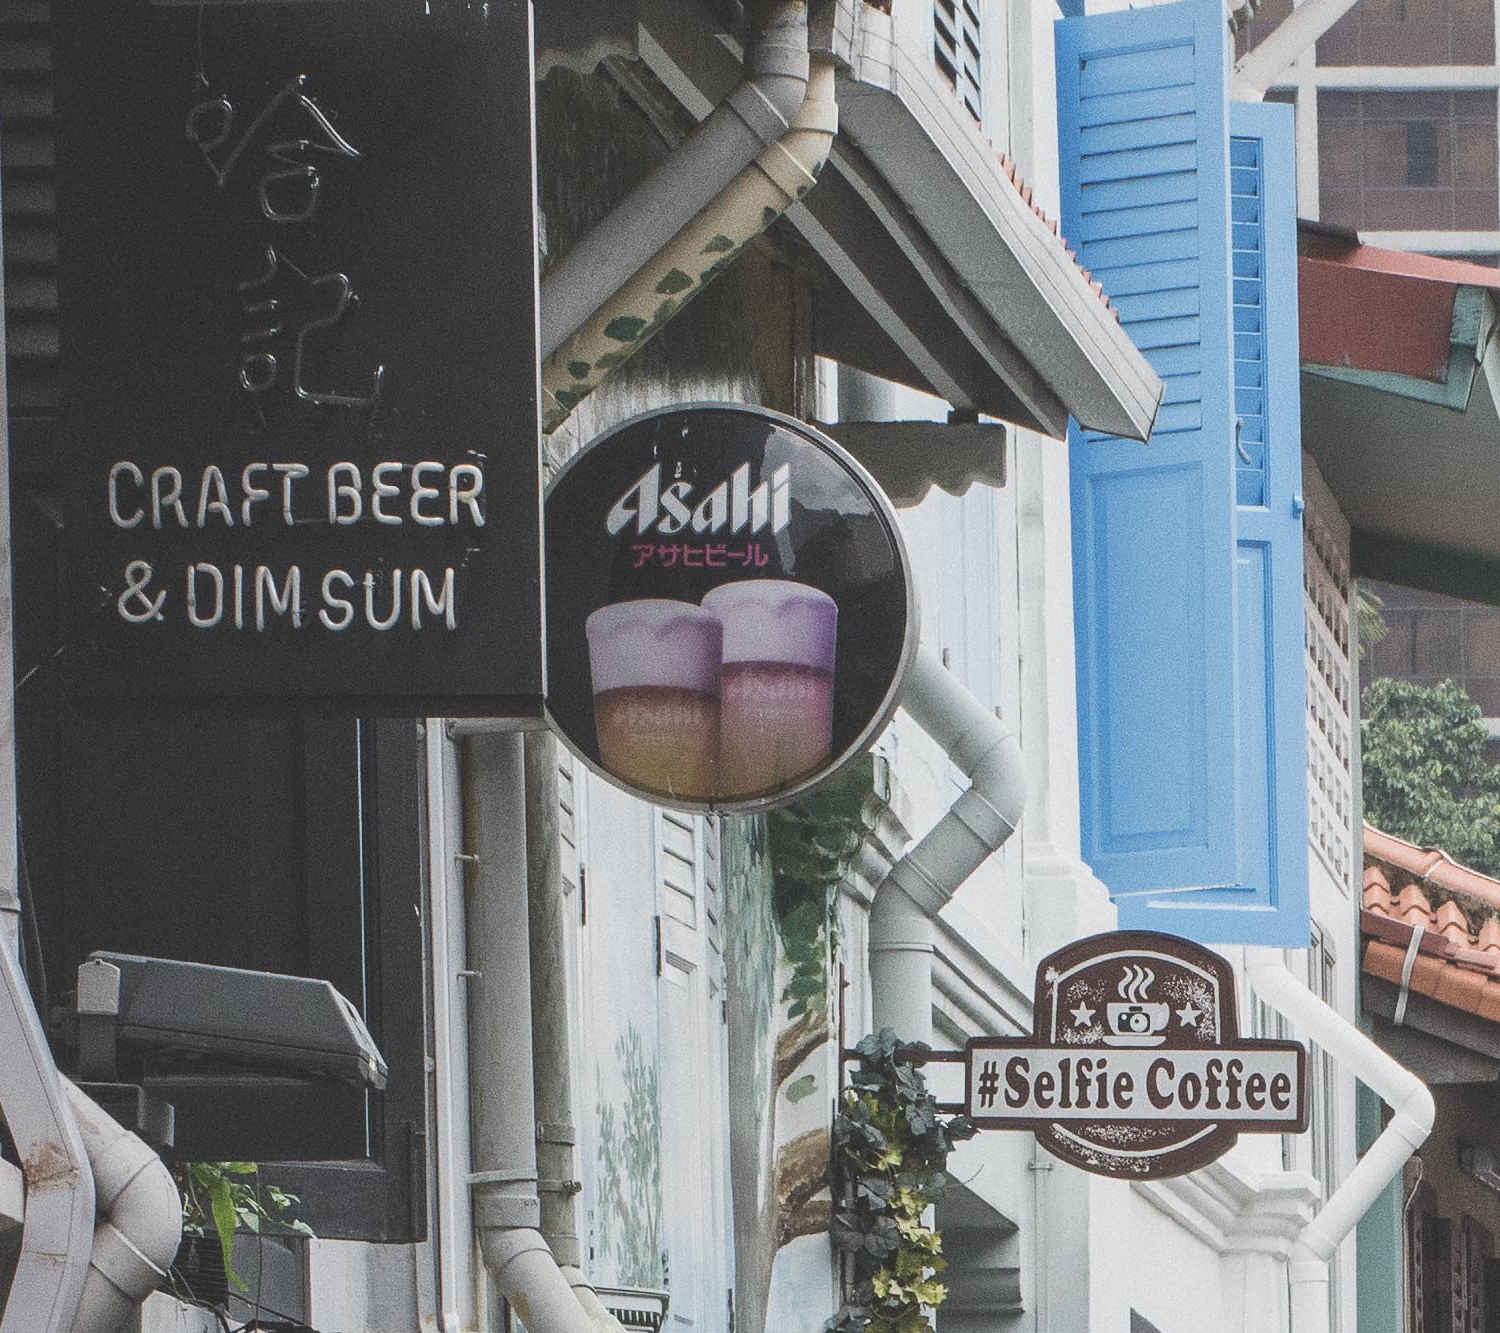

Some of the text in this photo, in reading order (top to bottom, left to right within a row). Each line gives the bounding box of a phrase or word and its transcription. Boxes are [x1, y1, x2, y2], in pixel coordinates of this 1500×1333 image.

[107, 460, 486, 529] CRAFT BEER
[606, 461, 793, 537] Asahi
[631, 543, 770, 569] アサヒビール
[116, 559, 456, 632] & DIM SUM
[978, 1057, 1291, 1110] #Selfie Coffee
